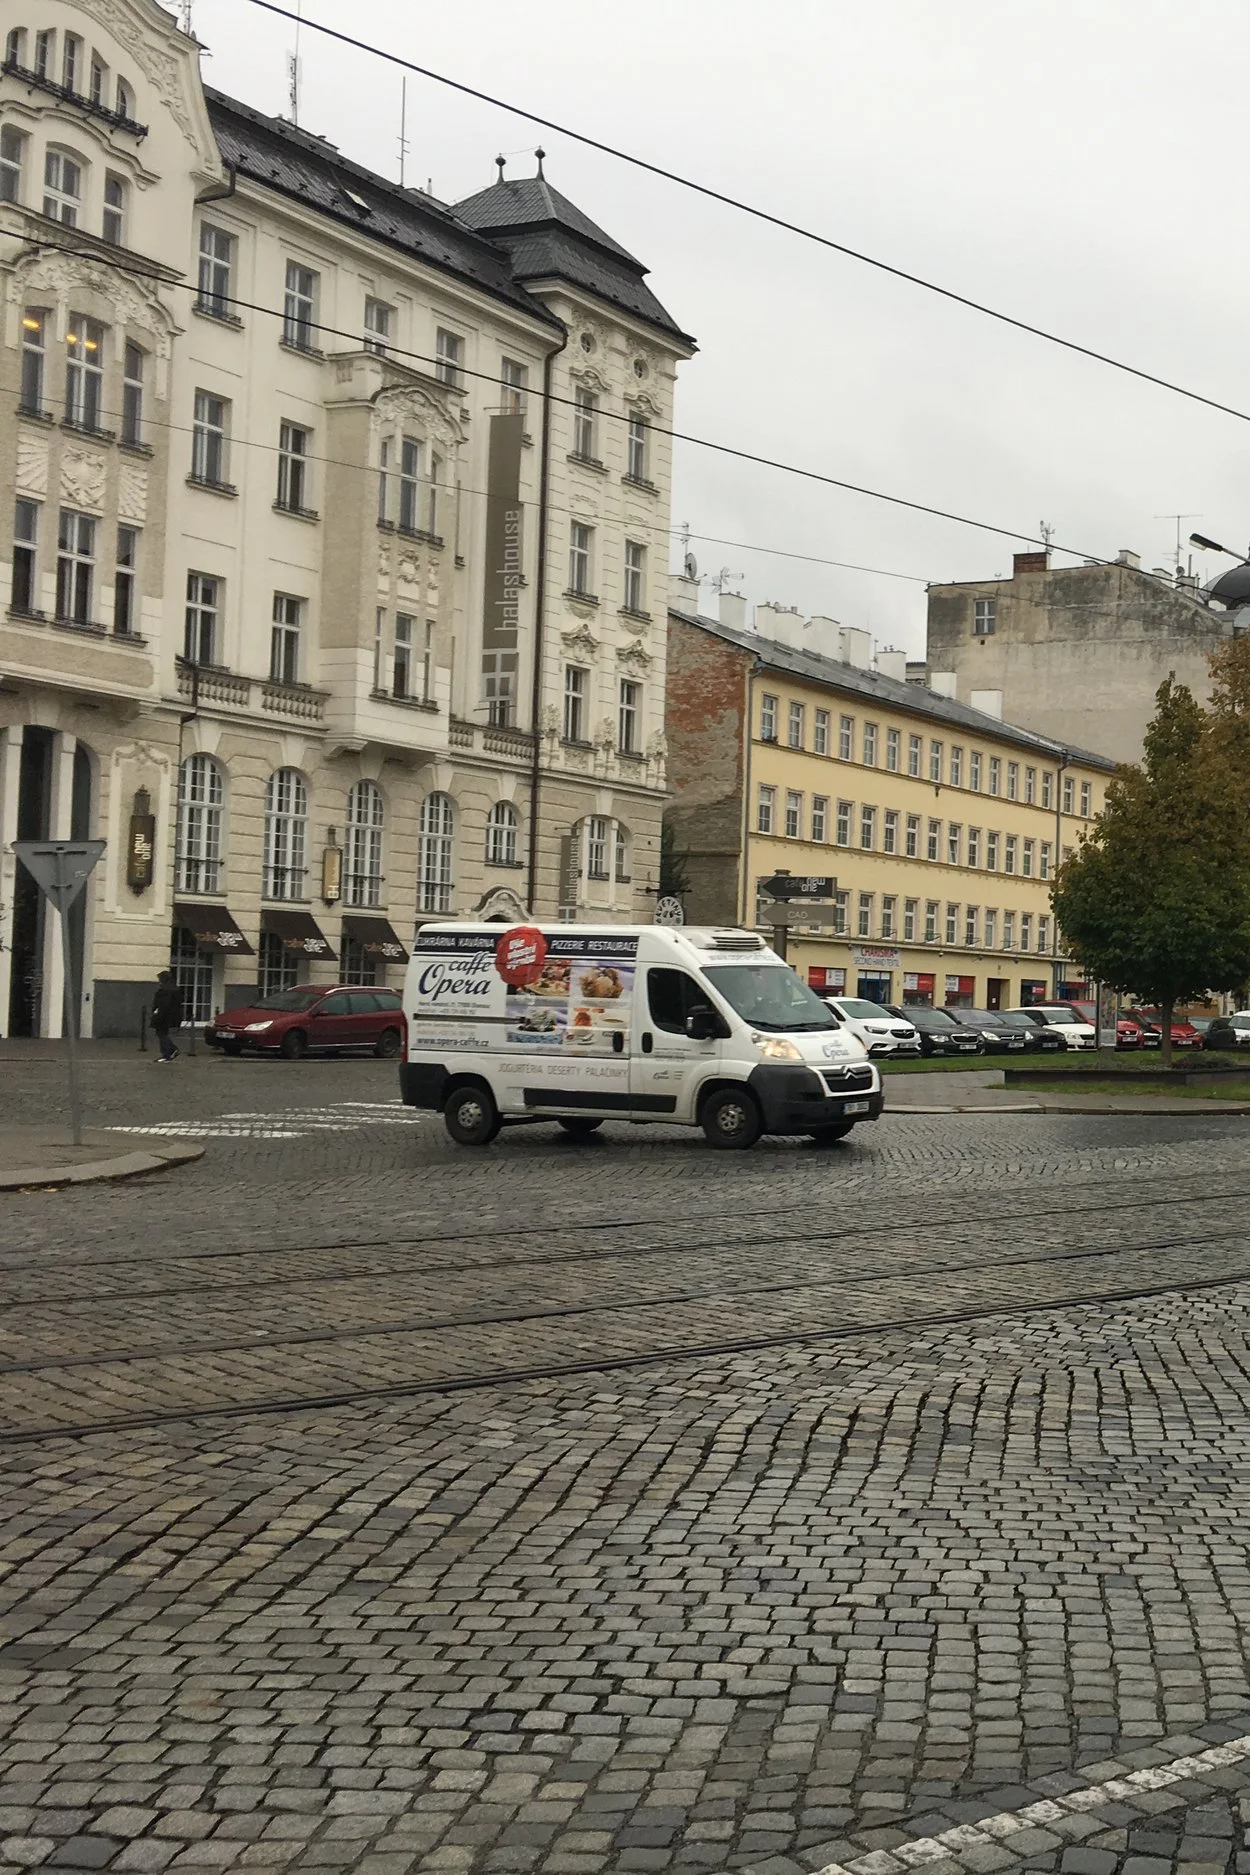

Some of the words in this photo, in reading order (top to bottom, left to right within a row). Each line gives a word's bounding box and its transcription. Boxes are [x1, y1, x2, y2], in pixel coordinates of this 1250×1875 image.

[494, 508, 520, 632] balashouse
[135, 833, 145, 854] new
[141, 842, 152, 860] one
[801, 883, 818, 893] one
[806, 876, 826, 887] new
[457, 937, 495, 948] KAVÁRNA
[551, 940, 584, 950] PIZZERIE
[587, 941, 639, 952] RESTAURACE
[418, 963, 492, 1002] Opera
[498, 1063, 543, 1074] JOGURTÉRIA
[547, 1065, 581, 1076] DESERTY
[584, 1066, 628, 1079] PALAČINKY
